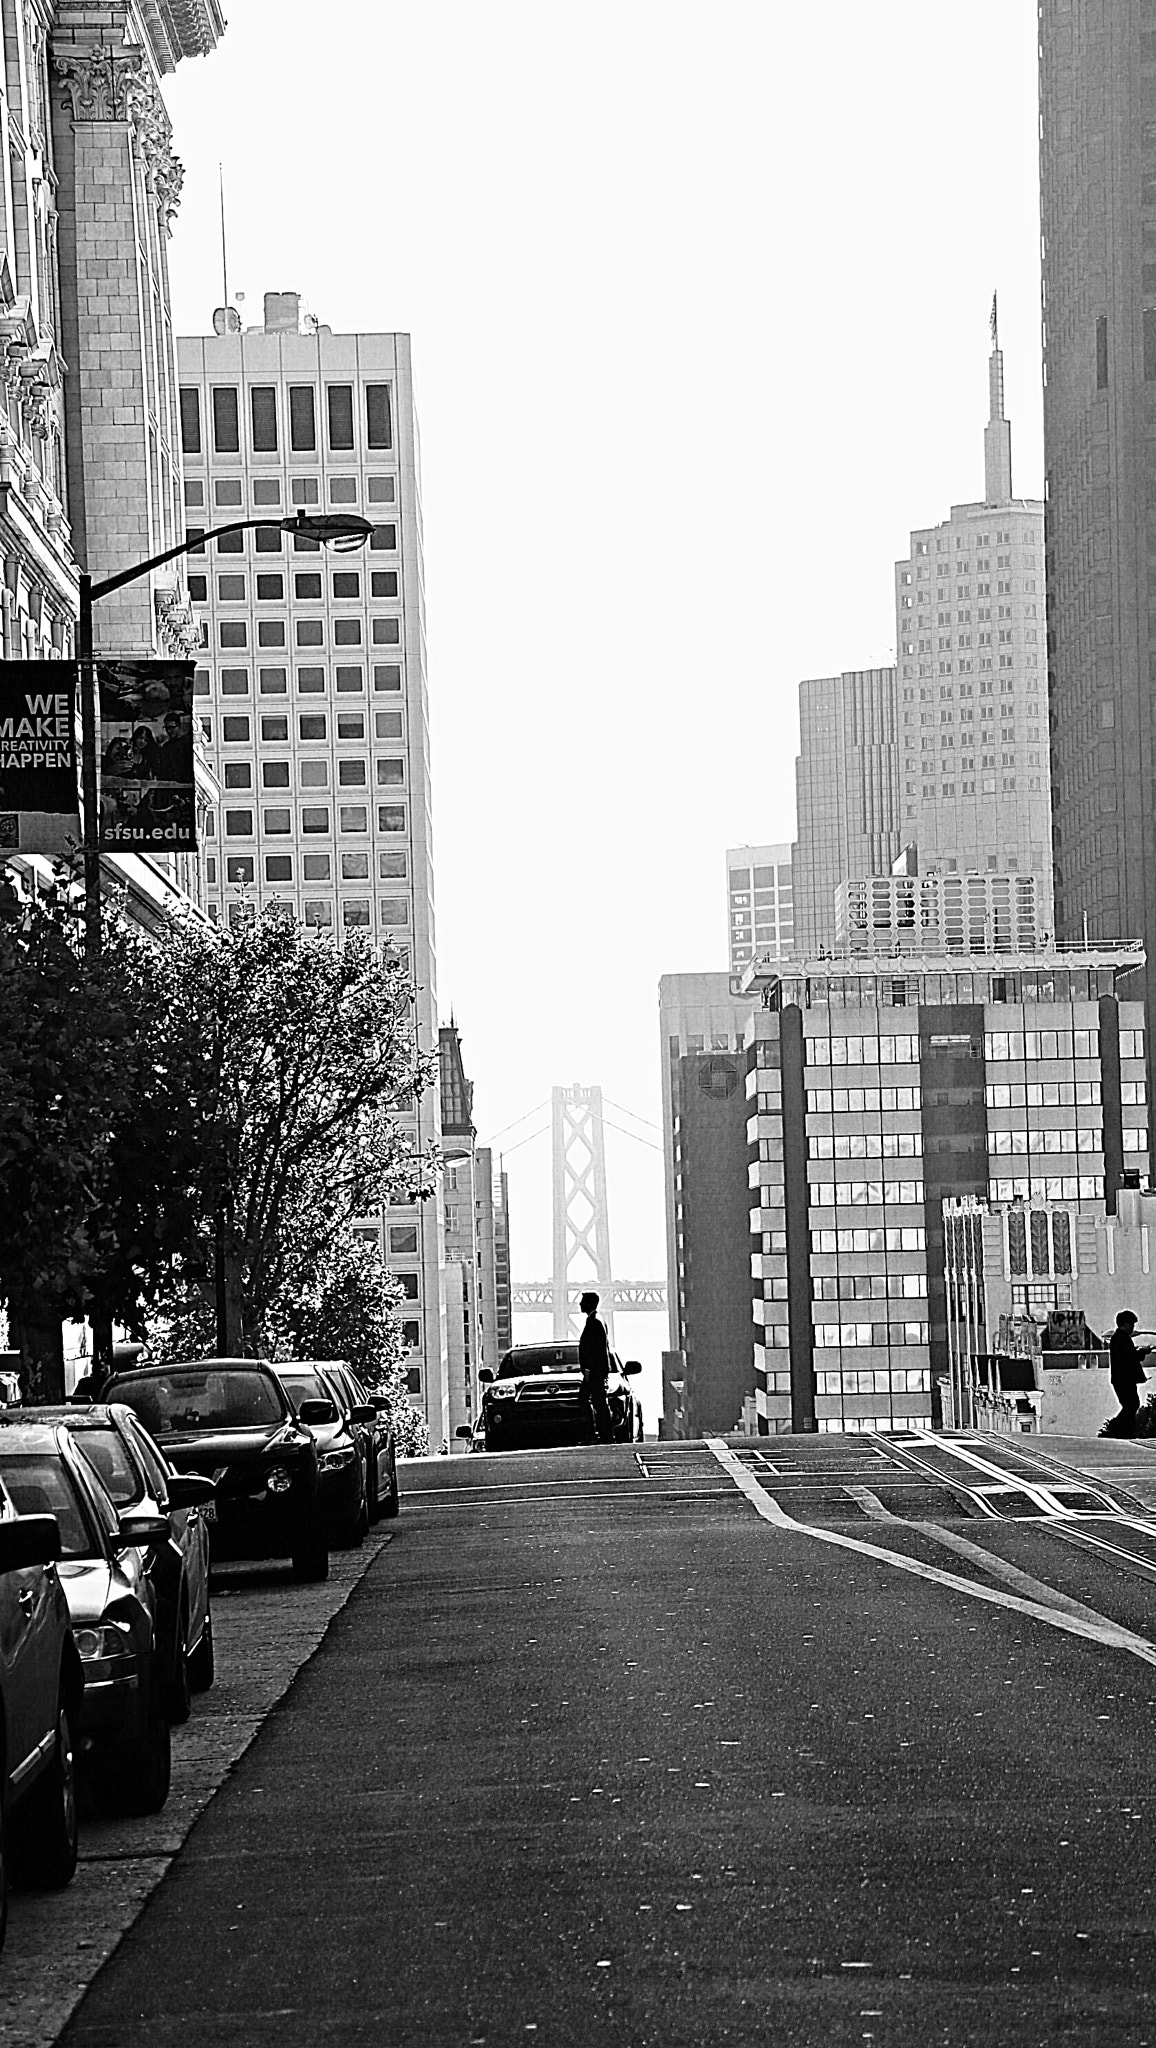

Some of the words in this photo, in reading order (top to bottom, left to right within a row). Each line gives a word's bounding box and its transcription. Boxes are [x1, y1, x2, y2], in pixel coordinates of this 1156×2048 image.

[25, 694, 69, 714] WE
[0, 718, 70, 738] MAKE
[0, 740, 69, 752] REATIVITY
[104, 823, 190, 840] sfsu.edu
